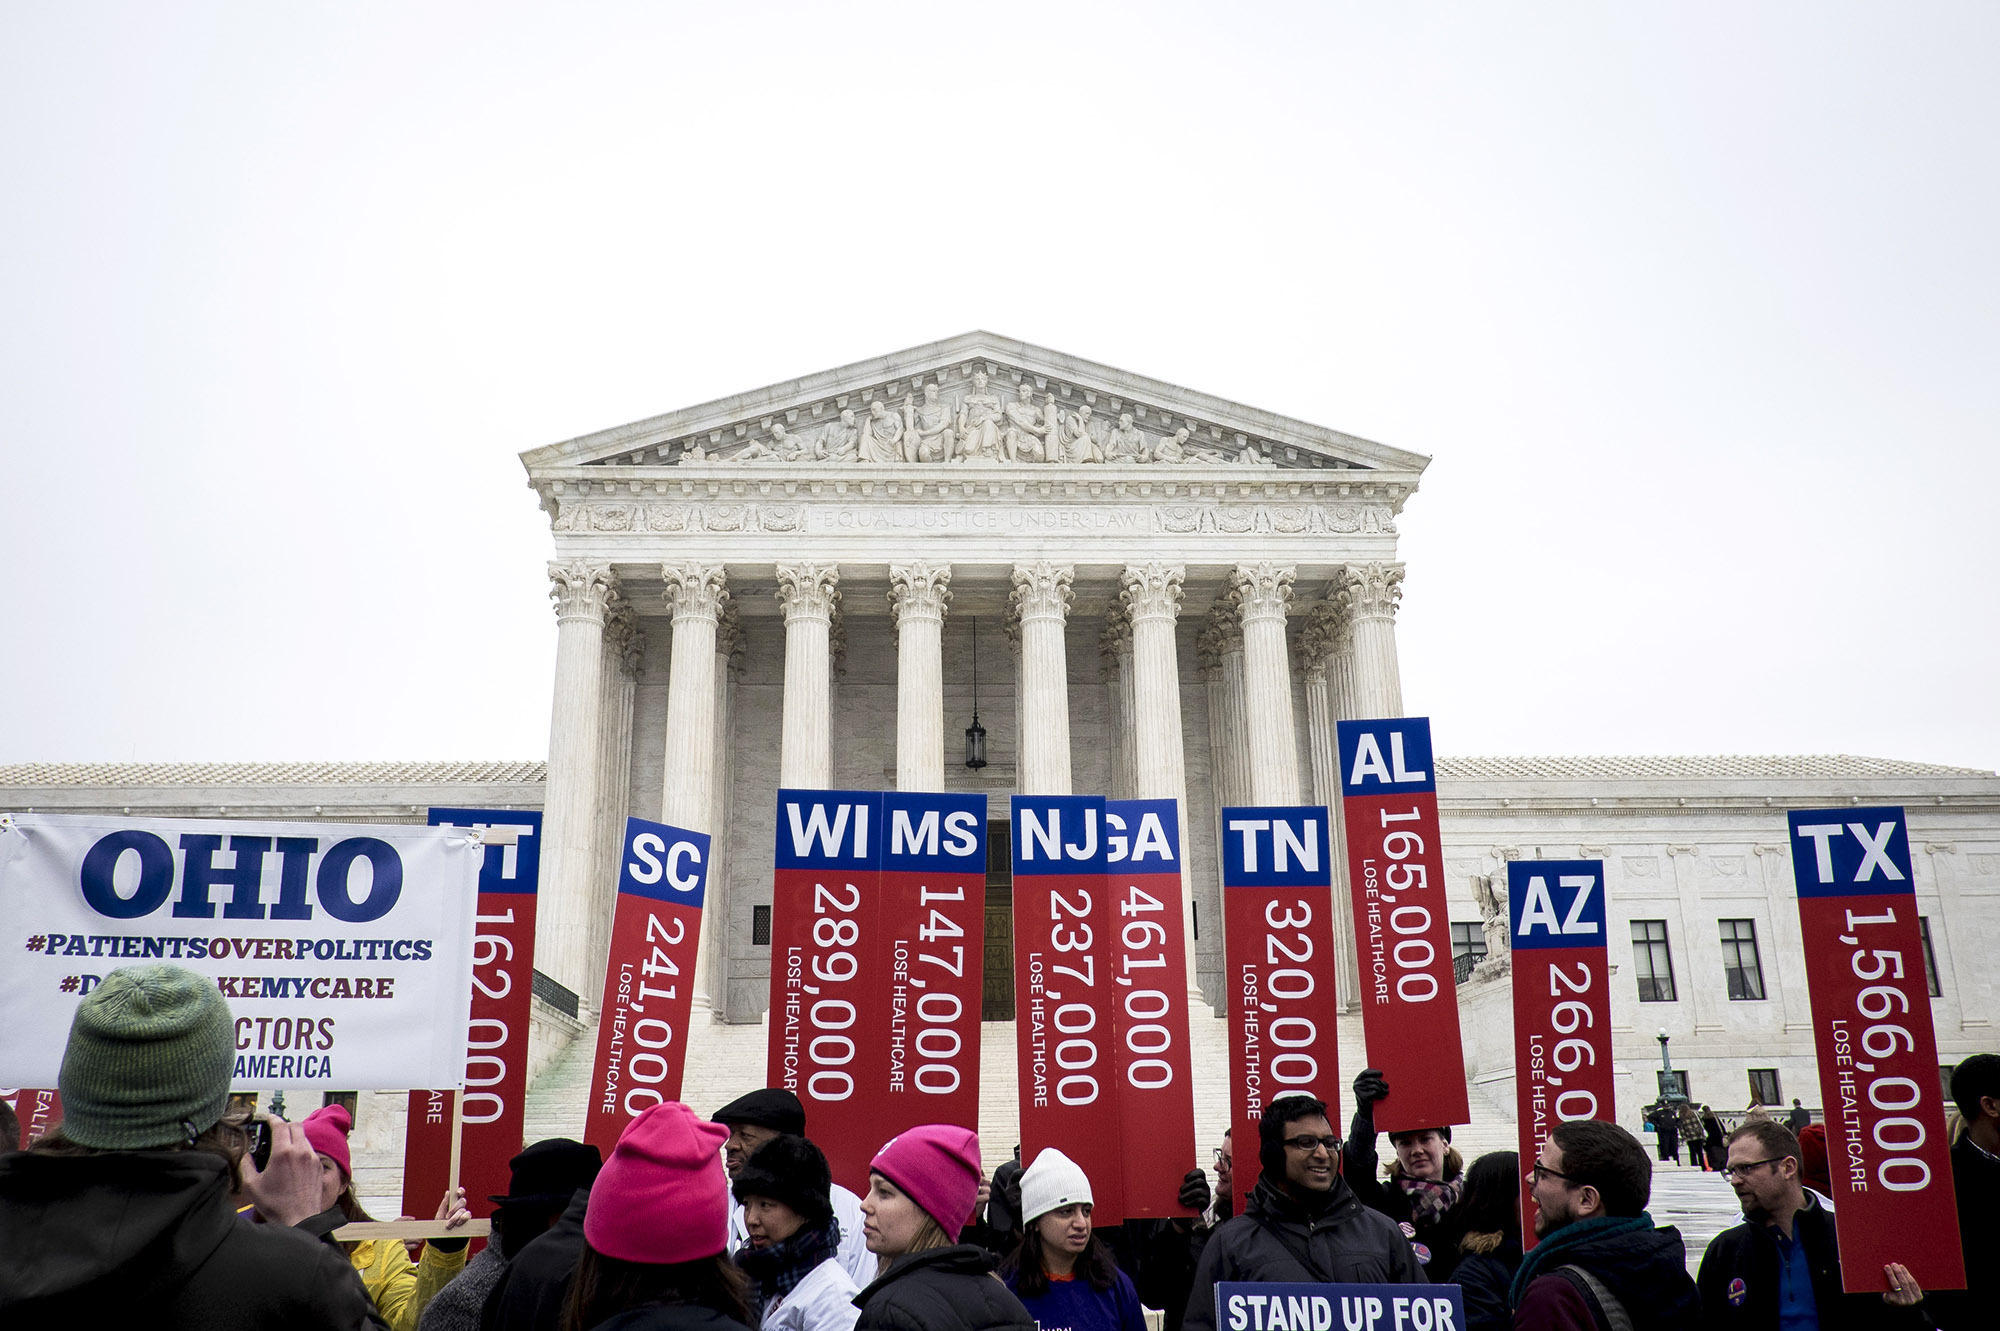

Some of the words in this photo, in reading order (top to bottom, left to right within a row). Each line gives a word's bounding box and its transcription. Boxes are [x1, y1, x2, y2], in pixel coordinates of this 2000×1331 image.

[824, 511, 902, 528] EQUAL
[909, 511, 996, 528] JUSTICE
[1009, 511, 1088, 528] UNDER
[1095, 511, 1138, 527] LAW
[1350, 732, 1426, 785] AL
[786, 803, 869, 858] WI
[891, 809, 978, 857] MS
[1020, 808, 1098, 861] NJ
[1229, 819, 1319, 873] TN
[1798, 821, 1905, 883] TX
[80, 830, 403, 923] OHIO
[628, 832, 702, 892] SC
[1363, 859, 1379, 899] LOSE
[1380, 806, 1438, 1003] 165,000
[1518, 875, 1598, 935] AZ
[26, 934, 432, 962] #PATIENTSOVERPOLITICS
[787, 947, 802, 988] LOSE
[893, 940, 909, 981] LOSE
[1029, 953, 1044, 994] LOSE
[1367, 902, 1390, 1005] HEALTHCARE
[617, 963, 634, 1005] LOSE
[802, 883, 860, 1101] 289,000
[907, 886, 965, 1094] 147,000
[1045, 889, 1099, 1106] 237,000
[1115, 886, 1173, 1089] 461,000
[1243, 964, 1257, 1006] LOSE
[1260, 900, 1318, 1102] 320,00
[233, 1055, 332, 1079] AMERICA
[602, 1008, 628, 1114] HEALTHCARE
[784, 992, 801, 1096] HEALTHCAR
[890, 985, 907, 1093] HEALTHCARE
[1031, 998, 1048, 1108] HEALTHCARE
[1244, 1010, 1262, 1120] HEALTHCARE
[1530, 1034, 1545, 1081] LOSE
[1832, 1020, 1853, 1066] LOSE
[1839, 907, 1931, 1192] 1,566,000
[1839, 1071, 1868, 1192] HEALTHCARE
[1228, 1295, 1332, 1331] STAND
[1341, 1296, 1383, 1331] UP
[1392, 1298, 1457, 1331] FOR
